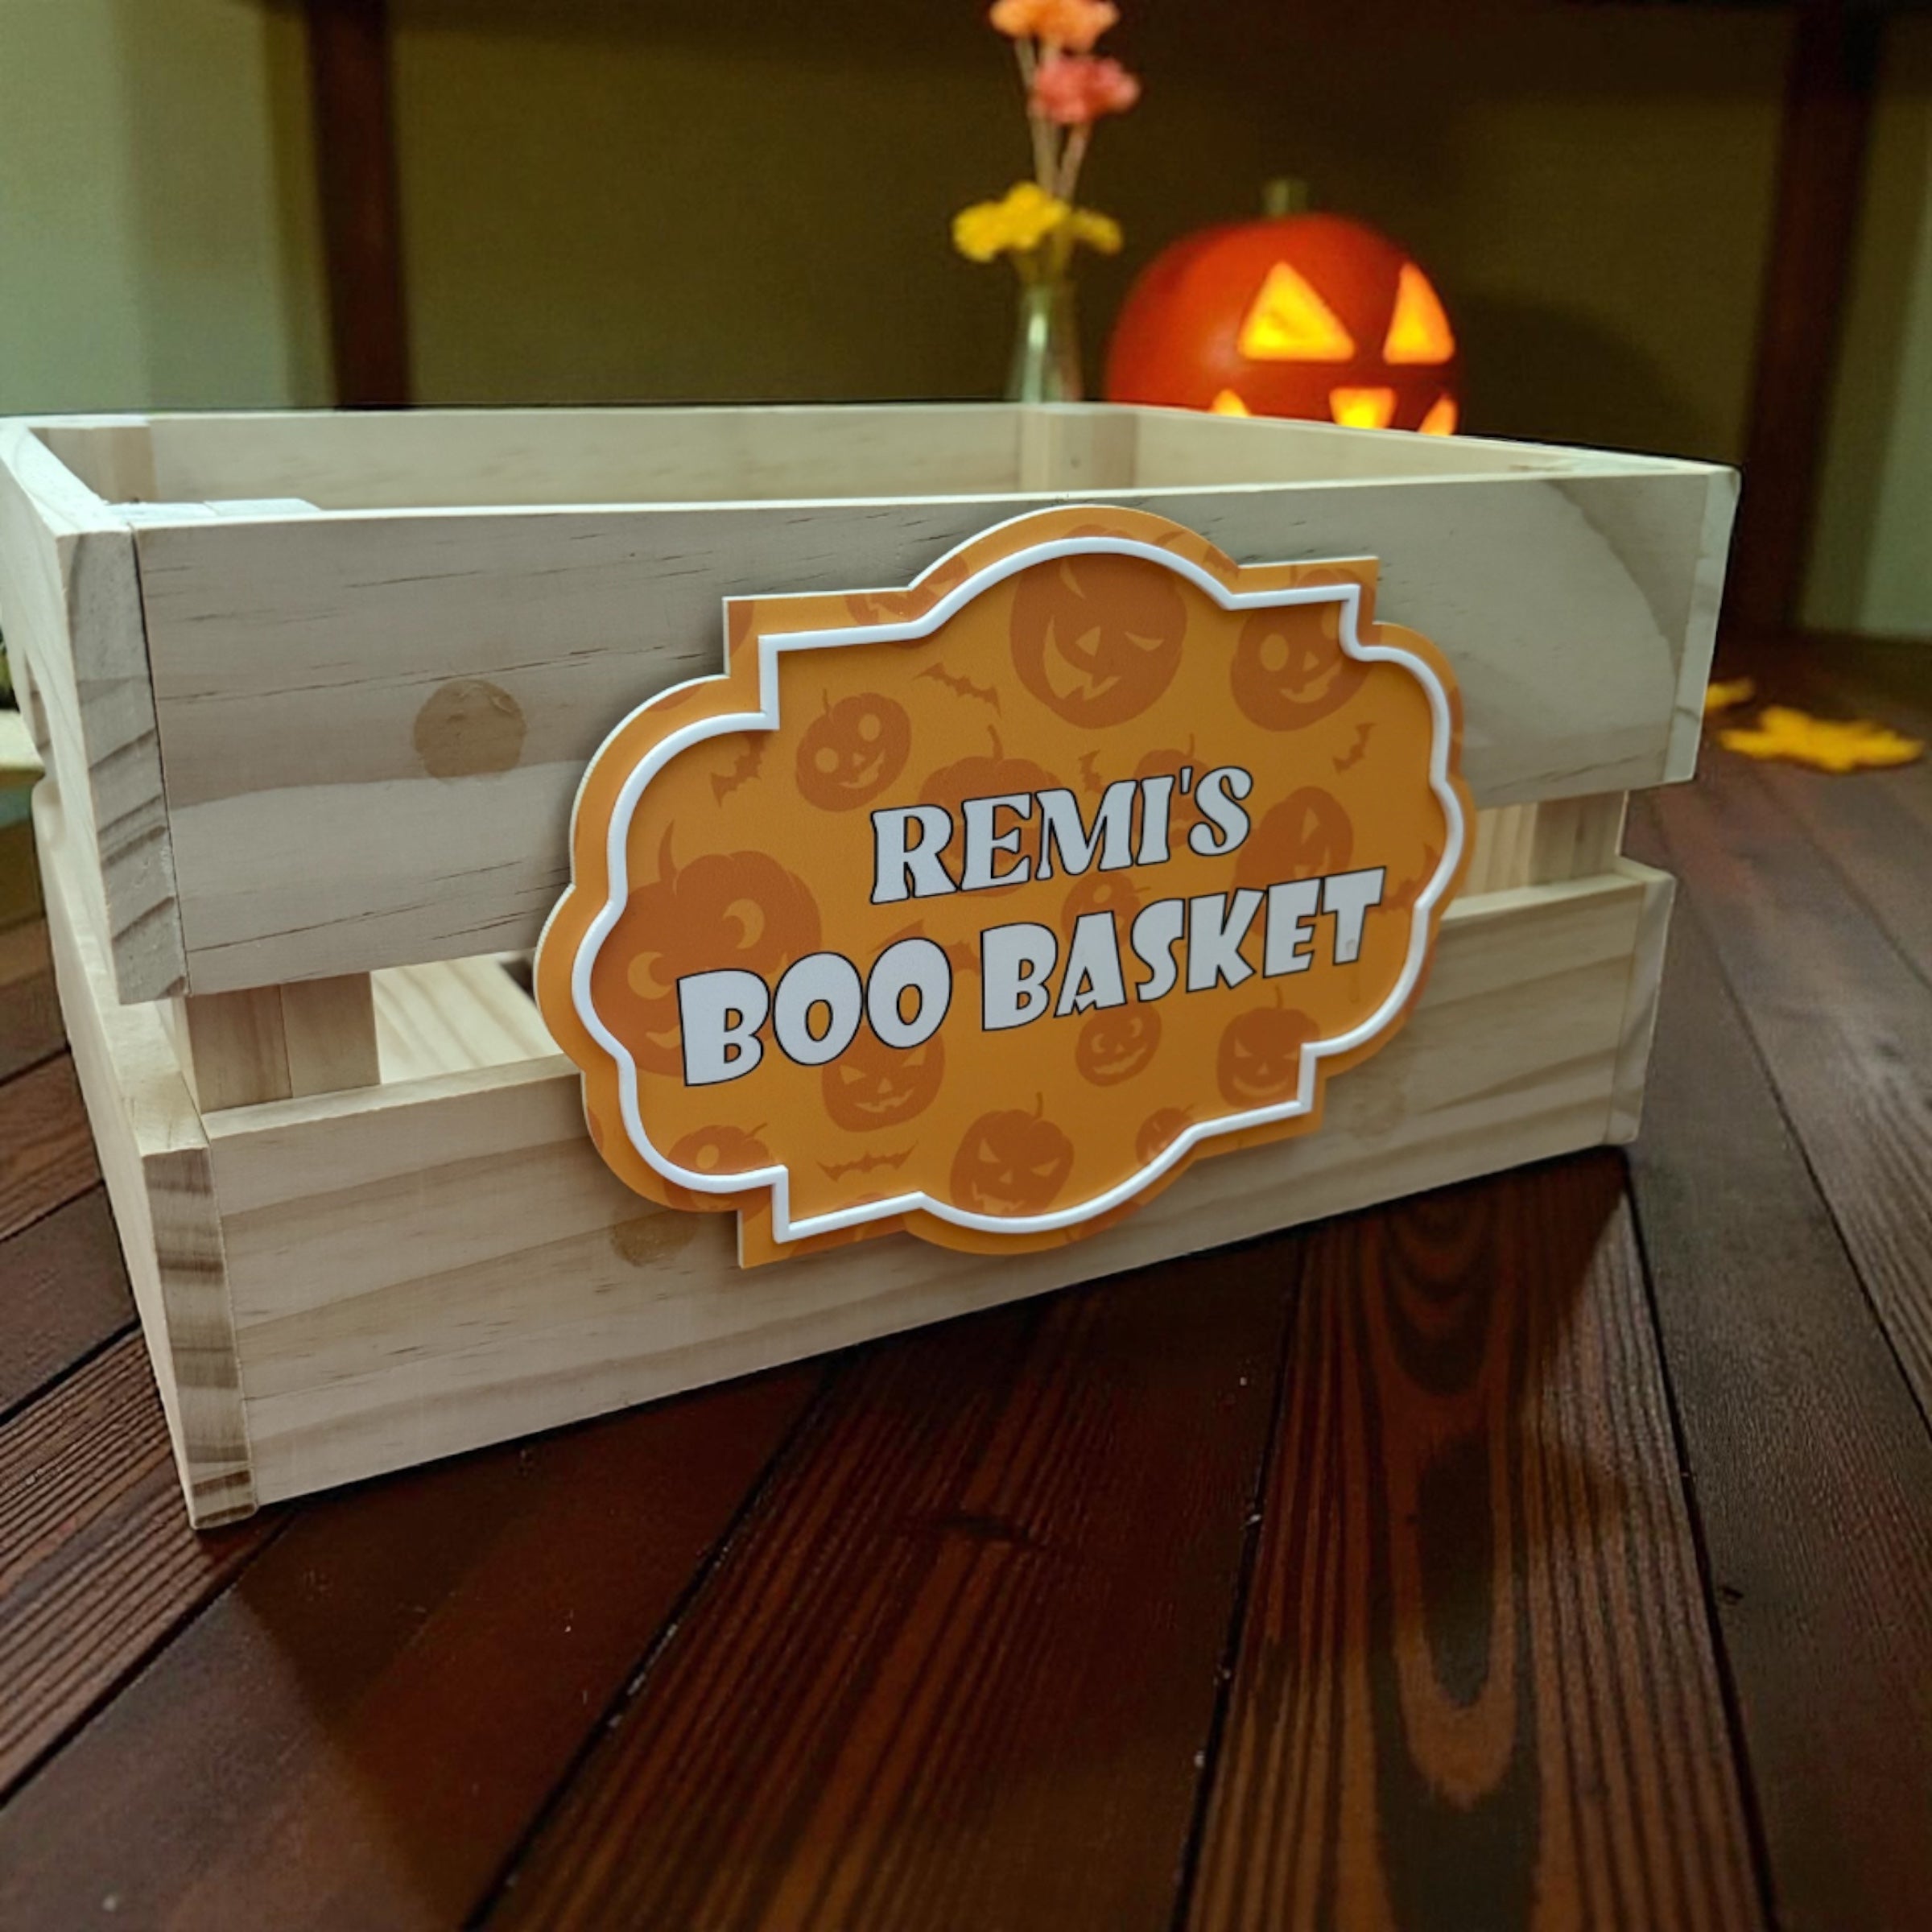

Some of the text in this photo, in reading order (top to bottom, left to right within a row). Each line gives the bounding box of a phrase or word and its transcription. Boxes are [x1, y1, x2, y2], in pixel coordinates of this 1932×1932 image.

[870, 766, 1253, 905] REMI'S
[677, 867, 1386, 1087] BOO BASKET
